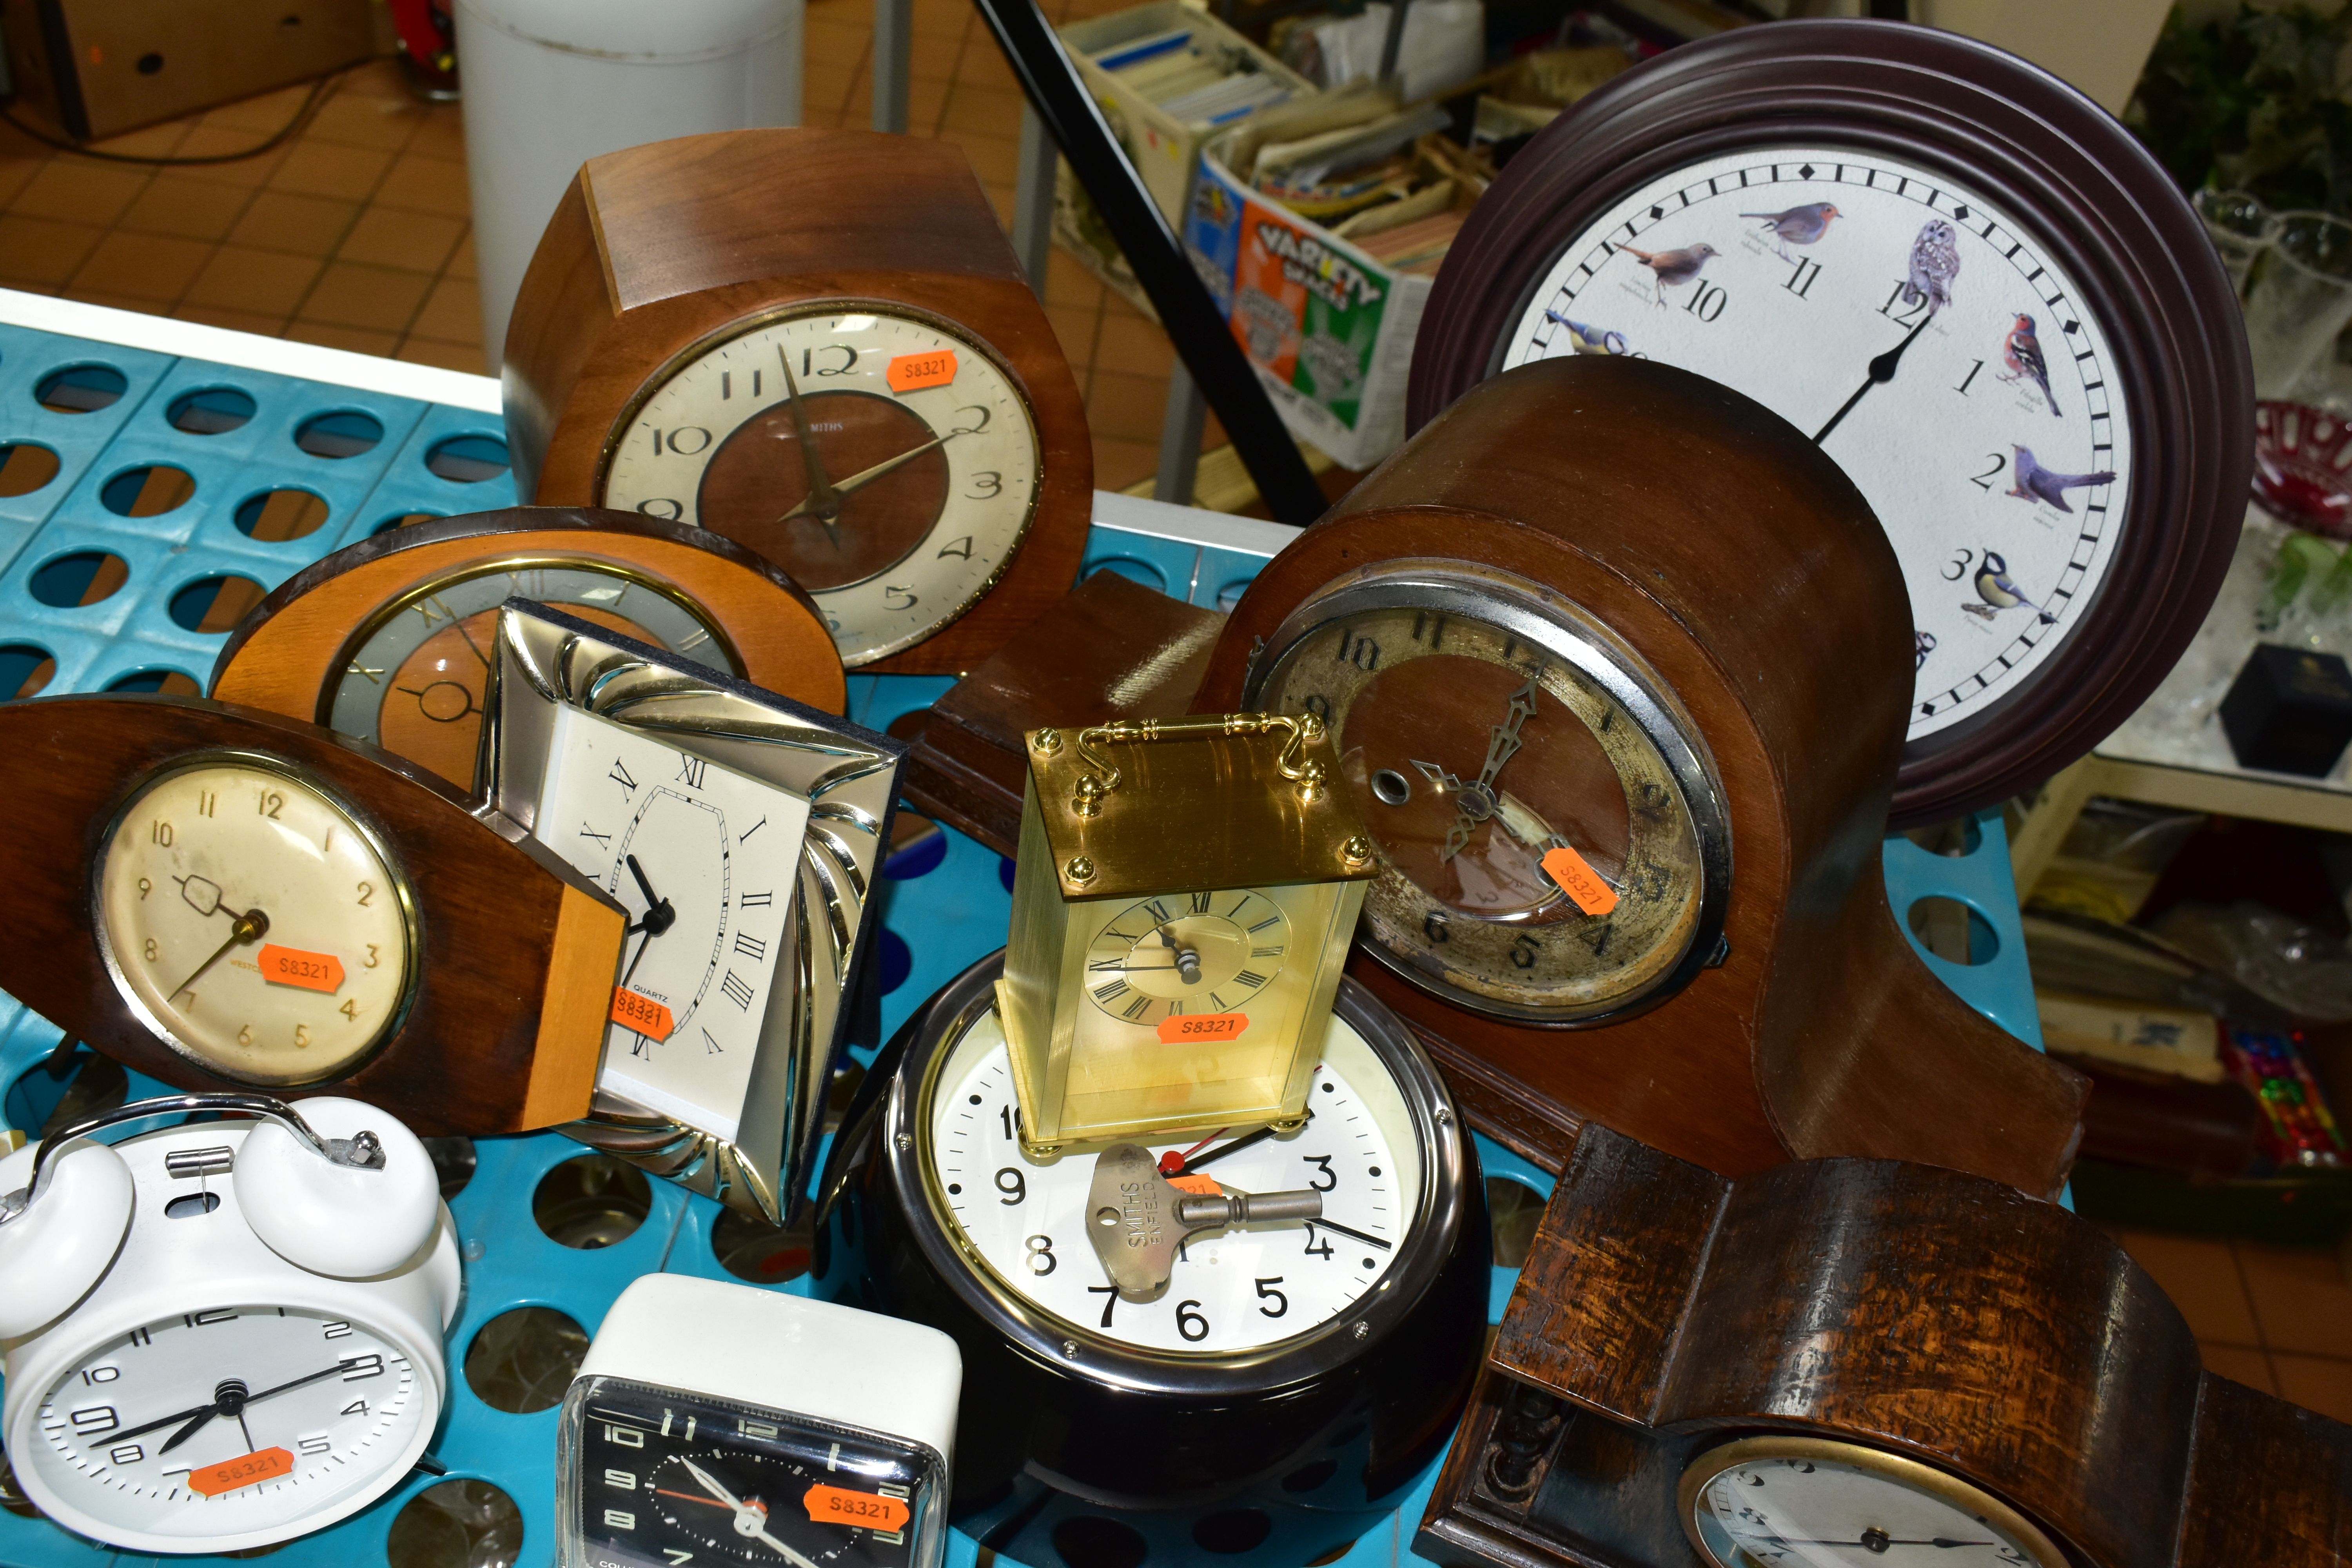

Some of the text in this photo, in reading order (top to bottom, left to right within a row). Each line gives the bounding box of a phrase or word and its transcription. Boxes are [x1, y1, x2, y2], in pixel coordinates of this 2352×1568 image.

[1257, 223, 1382, 307] VARIETY
[1780, 255, 1822, 301] 11
[1682, 278, 1727, 323] 10
[1876, 279, 1929, 334] 12
[803, 344, 859, 377] 12
[905, 359, 946, 379] S8321
[722, 369, 762, 400] 11
[1953, 359, 1984, 397] 1
[810, 422, 843, 432] MITHS
[952, 405, 991, 435] 2
[653, 426, 712, 456] 10
[964, 472, 1002, 499] 3
[1970, 454, 2006, 493] 2
[937, 537, 975, 561] 4
[1940, 549, 1973, 581] 3
[883, 584, 918, 610] 5
[411, 595, 450, 628] XI
[1412, 613, 1445, 651] 11
[1338, 629, 1381, 671] 10
[1601, 711, 1614, 733] 1
[609, 756, 638, 803] XI
[675, 753, 706, 790] XII
[200, 791, 216, 818] 11
[259, 791, 283, 820] 12
[153, 821, 173, 848] 10
[325, 828, 332, 851] 1
[580, 821, 612, 851] X
[740, 815, 766, 846] I
[138, 878, 152, 900] 9
[358, 882, 372, 906] 2
[742, 889, 772, 909] II
[1561, 866, 1602, 905] S8321
[1143, 901, 1170, 925] XI
[1187, 892, 1211, 913] XII
[1228, 895, 1251, 918] I
[1105, 927, 1138, 944] X
[1247, 916, 1280, 933] II
[1422, 910, 1450, 945] 6
[145, 938, 159, 961] 8
[734, 929, 766, 963] III
[1250, 946, 1284, 957] III
[1508, 933, 1542, 969] 5
[1577, 923, 1612, 957] 4
[279, 958, 328, 979] S8321
[364, 944, 378, 968] 3
[1089, 957, 1123, 972] IX
[721, 968, 754, 1012] IIII
[1093, 978, 1131, 1004] VIII
[1233, 969, 1268, 989] IIII
[184, 990, 197, 1013] 7
[633, 984, 668, 1003] QUARTZ
[1209, 992, 1229, 1011] V
[339, 998, 358, 1021] 4
[1122, 996, 1153, 1019] VII
[239, 1024, 251, 1045] 6
[295, 1024, 308, 1048] 5
[702, 1026, 724, 1054] V
[1181, 1020, 1235, 1034] S8321
[994, 1167, 1025, 1205] 9
[1303, 1154, 1337, 1192] 3
[1120, 1182, 1148, 1247] SMITHS
[1143, 1182, 1163, 1245] ENFIELD
[1304, 1222, 1335, 1261] 4
[1025, 1234, 1057, 1277] 8
[1087, 1285, 1120, 1327] 7
[1254, 1276, 1288, 1318] 5
[323, 1322, 352, 1339] 2
[1176, 1299, 1209, 1342] 6
[131, 1327, 151, 1347] 11
[82, 1366, 120, 1386] 10
[339, 1353, 385, 1383] 3
[71, 1406, 120, 1435] 9
[340, 1399, 370, 1416] 4
[604, 1425, 644, 1448] 10
[661, 1408, 697, 1441] 11
[738, 1419, 778, 1440] 12
[111, 1445, 143, 1465] 8
[298, 1435, 332, 1456] 5
[827, 1443, 840, 1472] 1
[217, 1455, 279, 1483] S8321
[604, 1468, 636, 1490] 9
[604, 1509, 635, 1530] 8
[829, 1496, 891, 1521] S8321
[663, 1548, 693, 1565] 7
